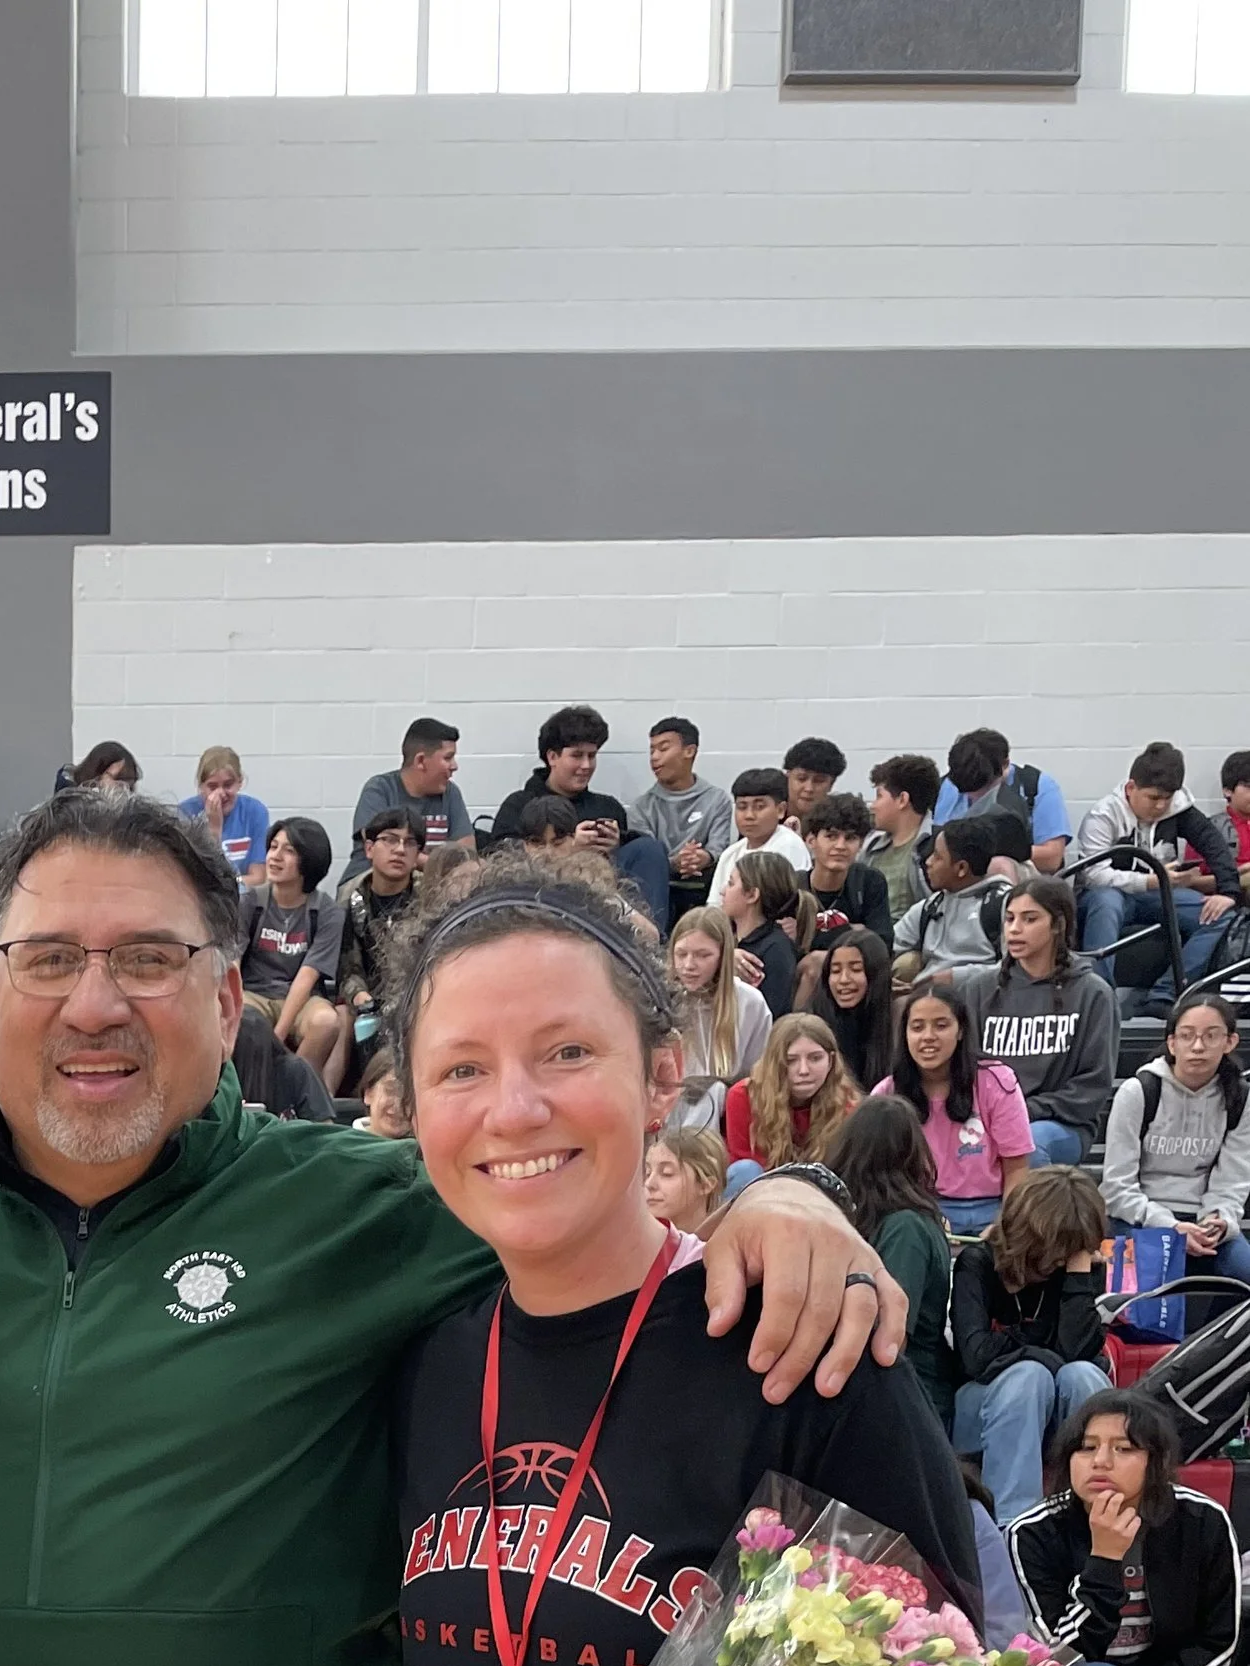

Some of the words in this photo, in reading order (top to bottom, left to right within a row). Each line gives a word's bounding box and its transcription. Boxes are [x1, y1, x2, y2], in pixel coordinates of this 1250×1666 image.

[162, 1252, 199, 1280] NORTH
[202, 1251, 233, 1263] EAST
[231, 1261, 247, 1279] ISD
[164, 1301, 237, 1324] ATHLETICS
[401, 1503, 724, 1637] ENERALS
